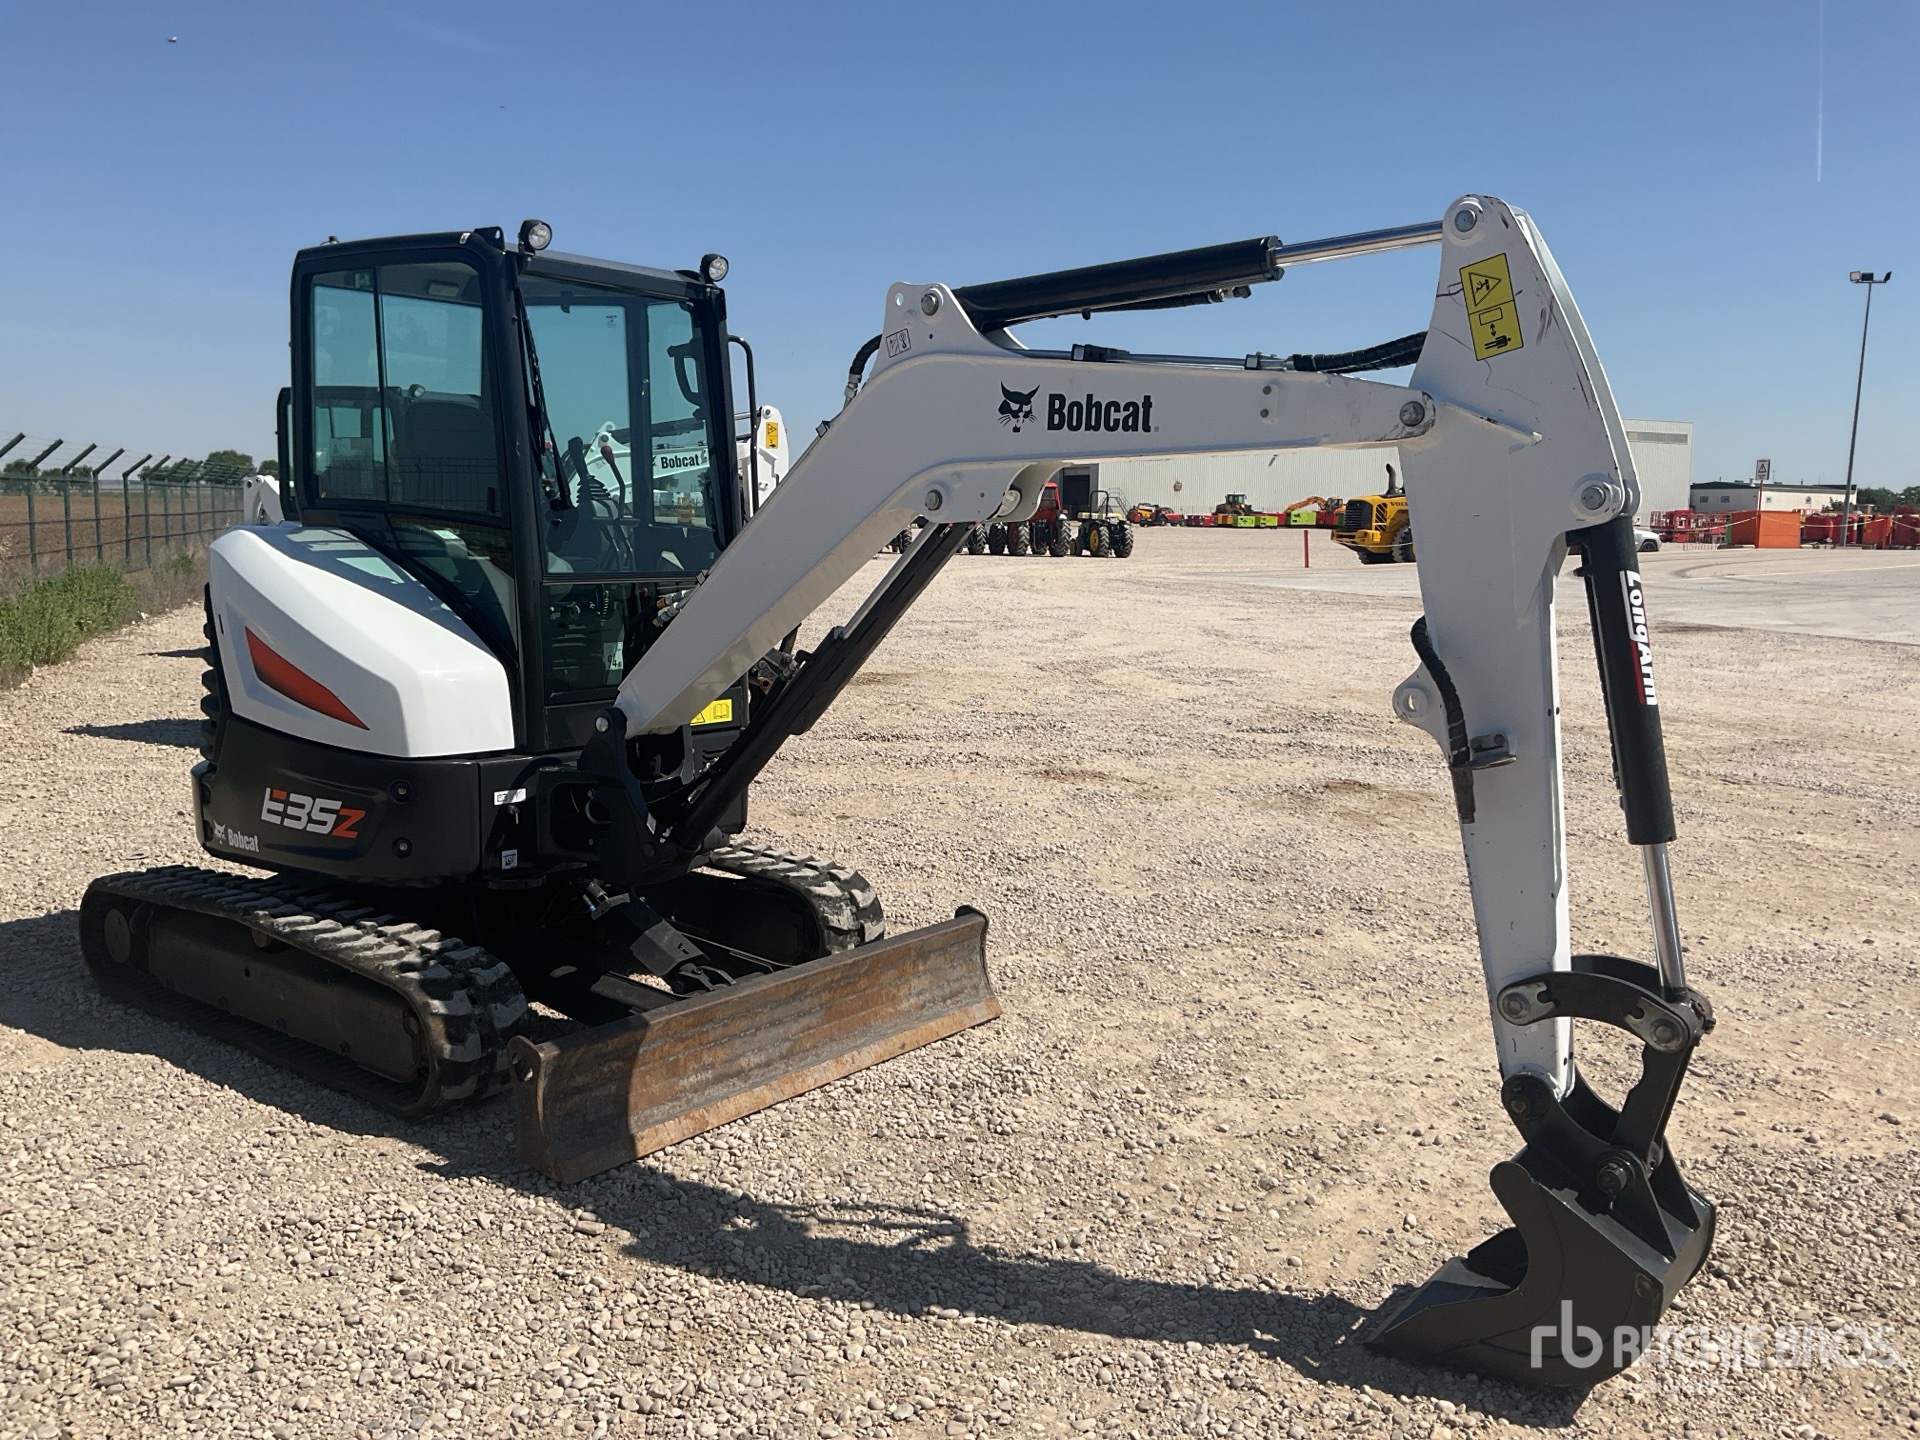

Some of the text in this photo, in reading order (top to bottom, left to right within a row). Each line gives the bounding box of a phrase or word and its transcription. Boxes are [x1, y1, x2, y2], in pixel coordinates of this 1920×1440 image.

[1047, 393, 1152, 433] Bobcat
[661, 455, 700, 470] Bobcat
[227, 828, 260, 853] Bobcat
